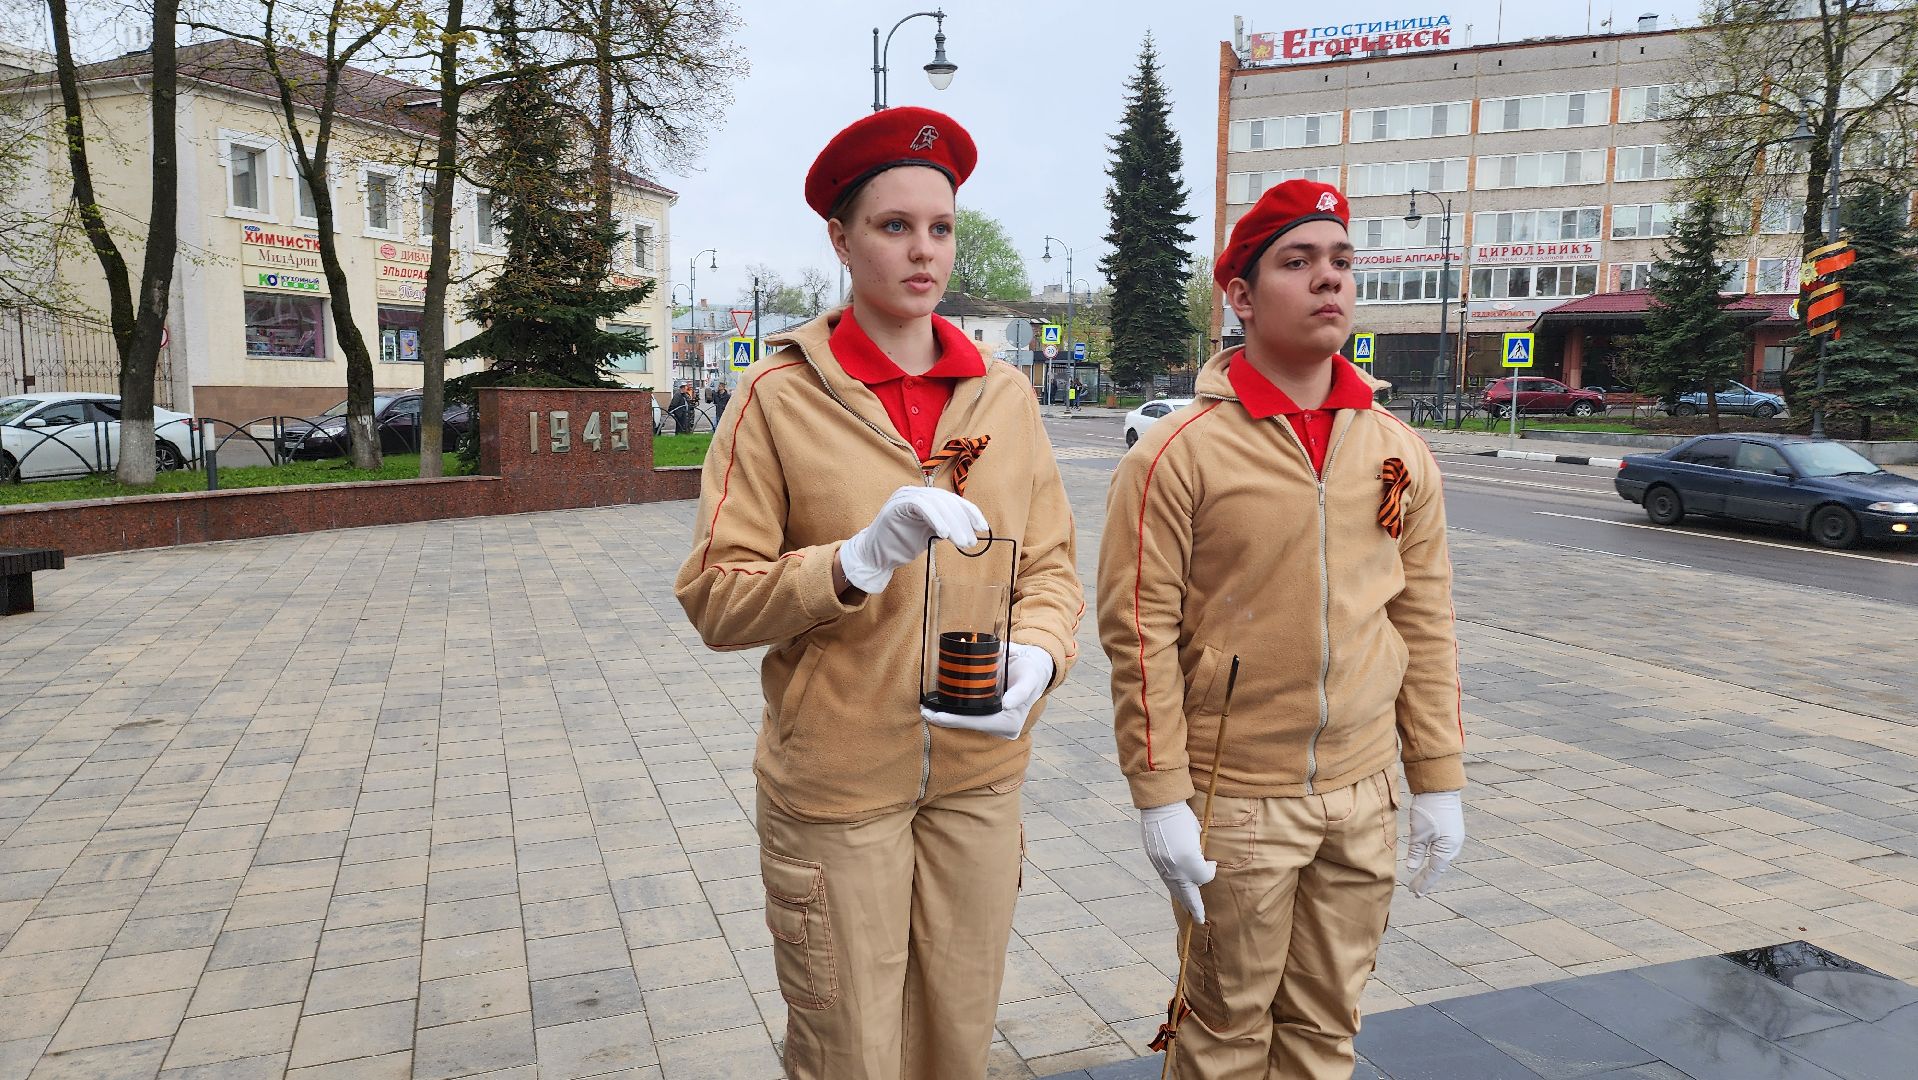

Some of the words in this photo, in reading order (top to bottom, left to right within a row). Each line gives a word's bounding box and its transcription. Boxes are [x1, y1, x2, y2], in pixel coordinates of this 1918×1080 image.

[1311, 14, 1451, 38] ГОСТИНИЦА
[244, 230, 321, 251] ХИМЧИСТК
[1478, 243, 1593, 258] ЦИРЮЛЬНИКЪ
[258, 248, 318, 268] МилАрин
[1353, 255, 1402, 264] ЛУХОВЫЕ
[1405, 252, 1463, 263] АППАРАТЫ
[529, 410, 630, 454] 1945
